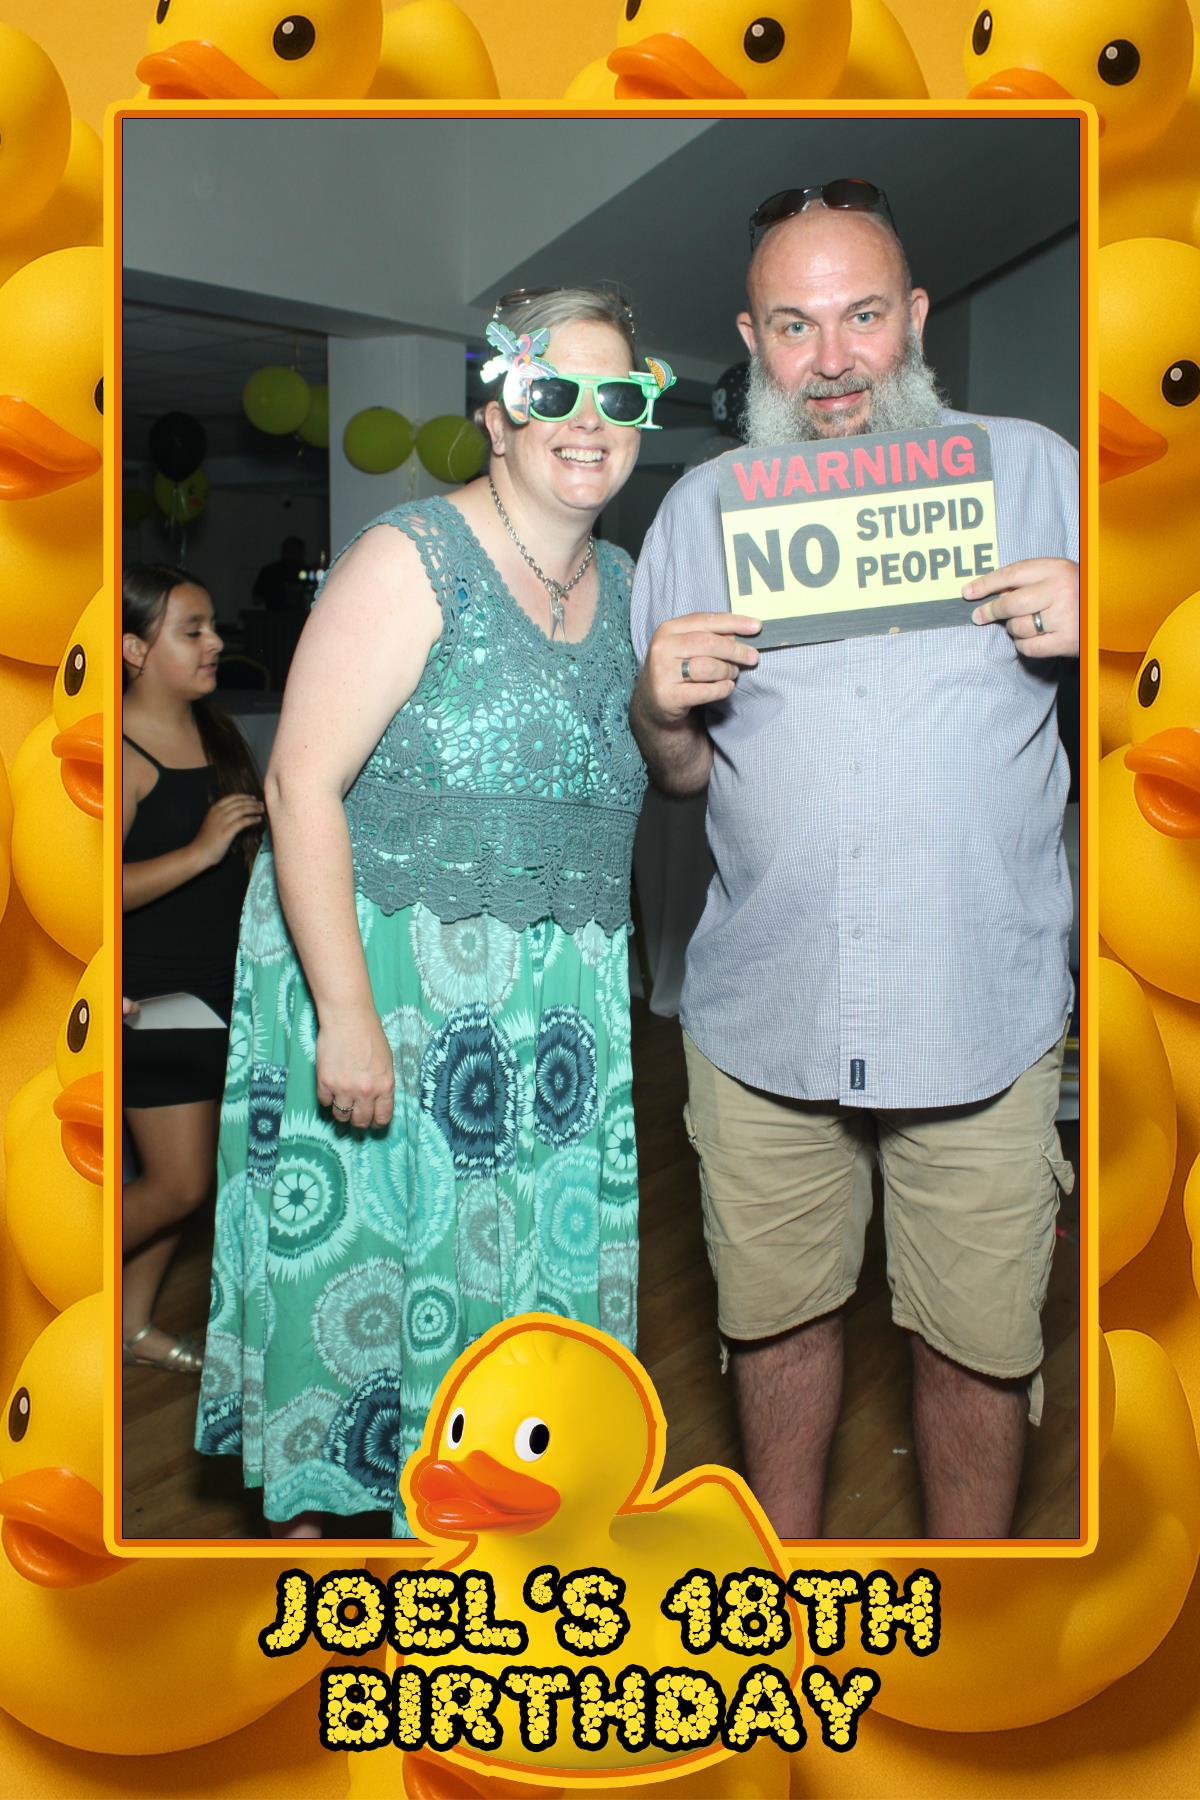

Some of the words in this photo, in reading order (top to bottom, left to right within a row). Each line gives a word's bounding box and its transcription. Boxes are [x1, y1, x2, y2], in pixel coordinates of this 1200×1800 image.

[732, 435, 976, 501] WARNING
[855, 496, 984, 541] STUPID
[732, 523, 841, 597] NO
[855, 542, 995, 589] PEOPLE
